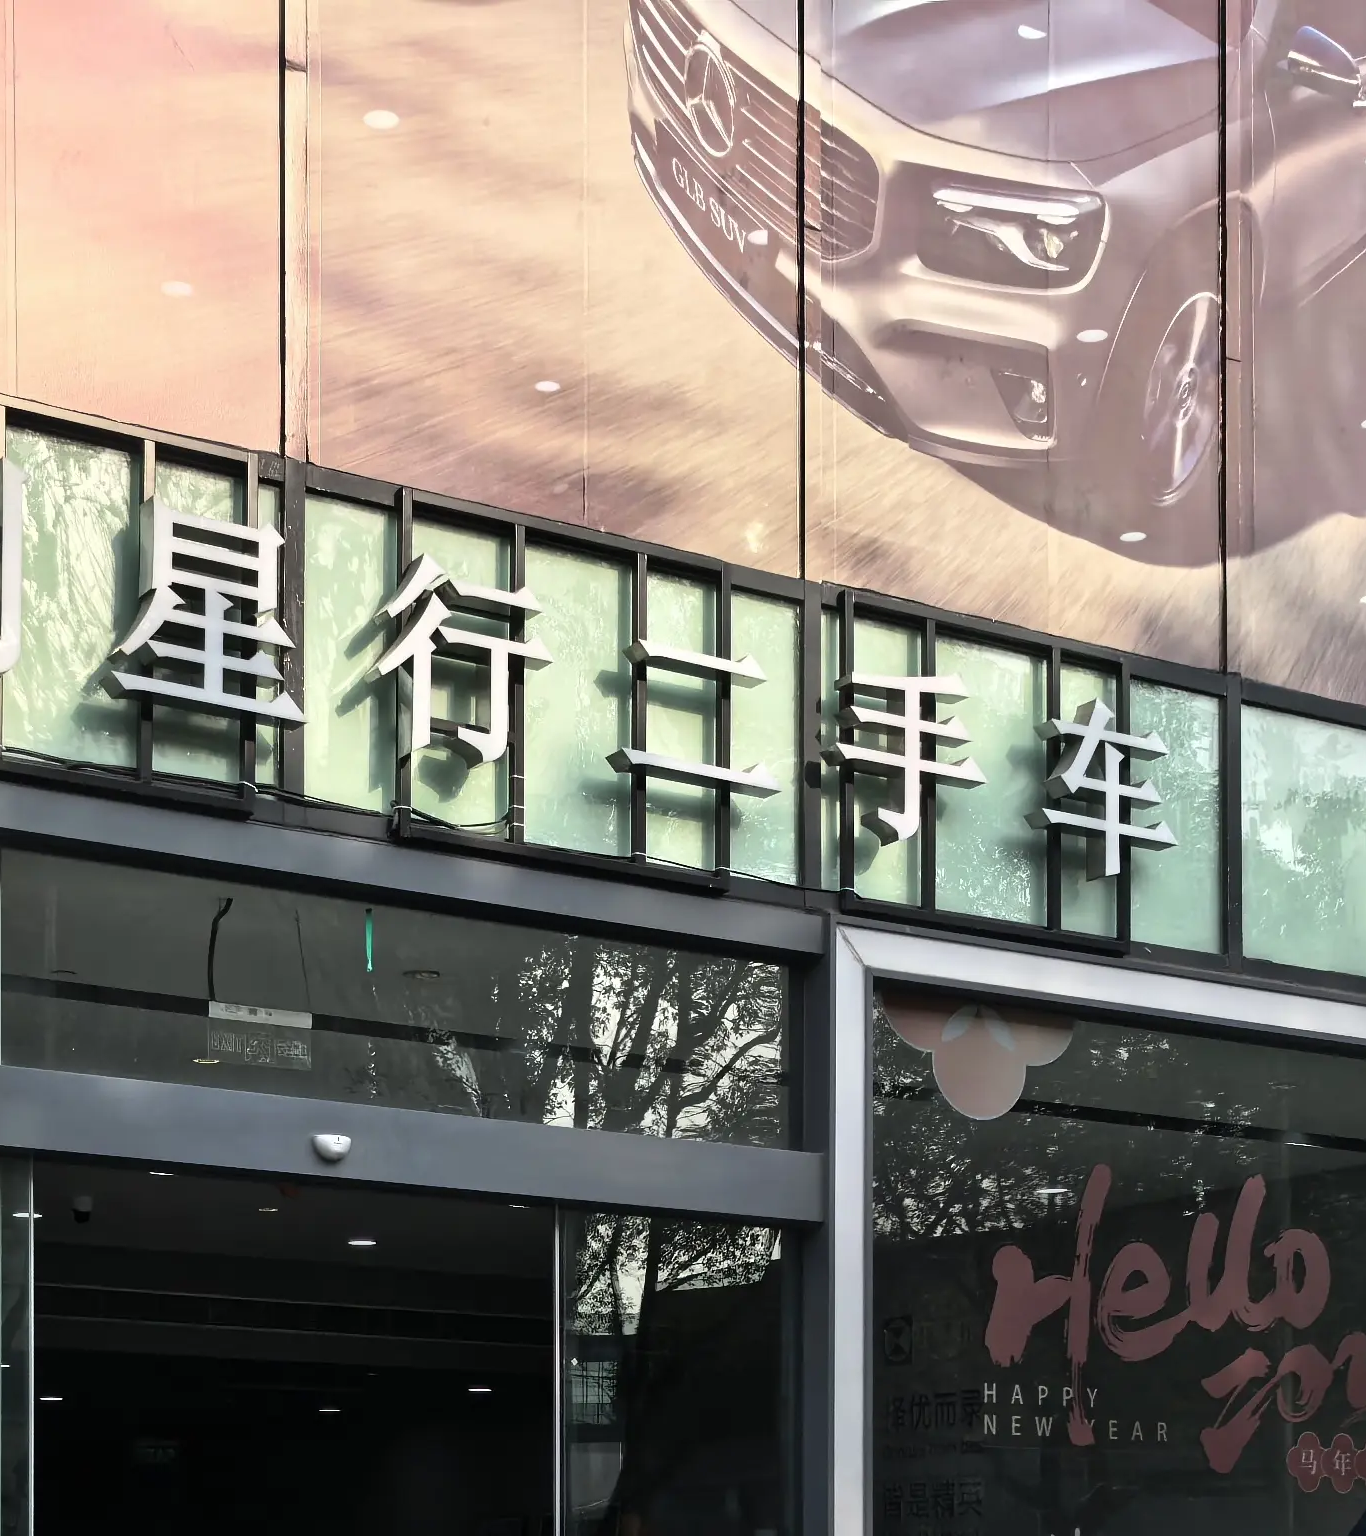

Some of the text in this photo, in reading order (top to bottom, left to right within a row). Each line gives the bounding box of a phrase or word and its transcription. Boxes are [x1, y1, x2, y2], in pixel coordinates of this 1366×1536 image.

[672, 158, 747, 254] GLB SUV
[985, 1163, 1331, 1446] Hello
[983, 1382, 1099, 1408] HAPPY
[983, 1413, 1054, 1437] NEW
